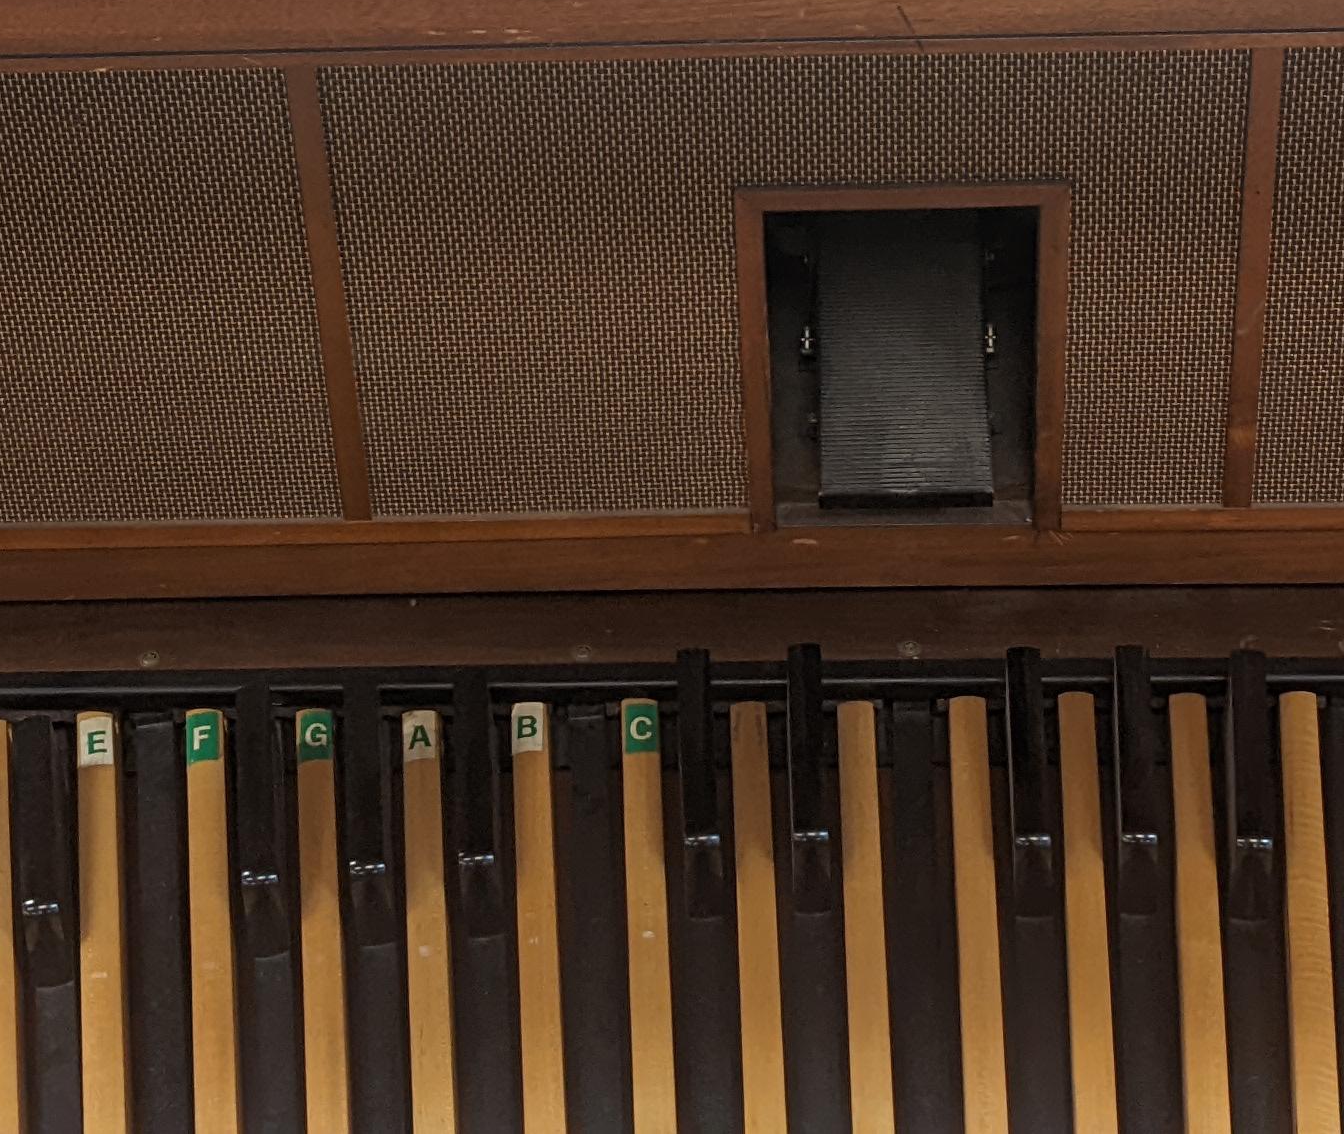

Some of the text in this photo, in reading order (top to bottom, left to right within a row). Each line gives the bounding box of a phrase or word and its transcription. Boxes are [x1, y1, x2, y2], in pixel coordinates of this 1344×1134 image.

[192, 725, 211, 751] F
[304, 722, 328, 747] G
[408, 724, 432, 750] A
[517, 714, 538, 740] B
[629, 715, 653, 741] C
[87, 730, 108, 755] E
